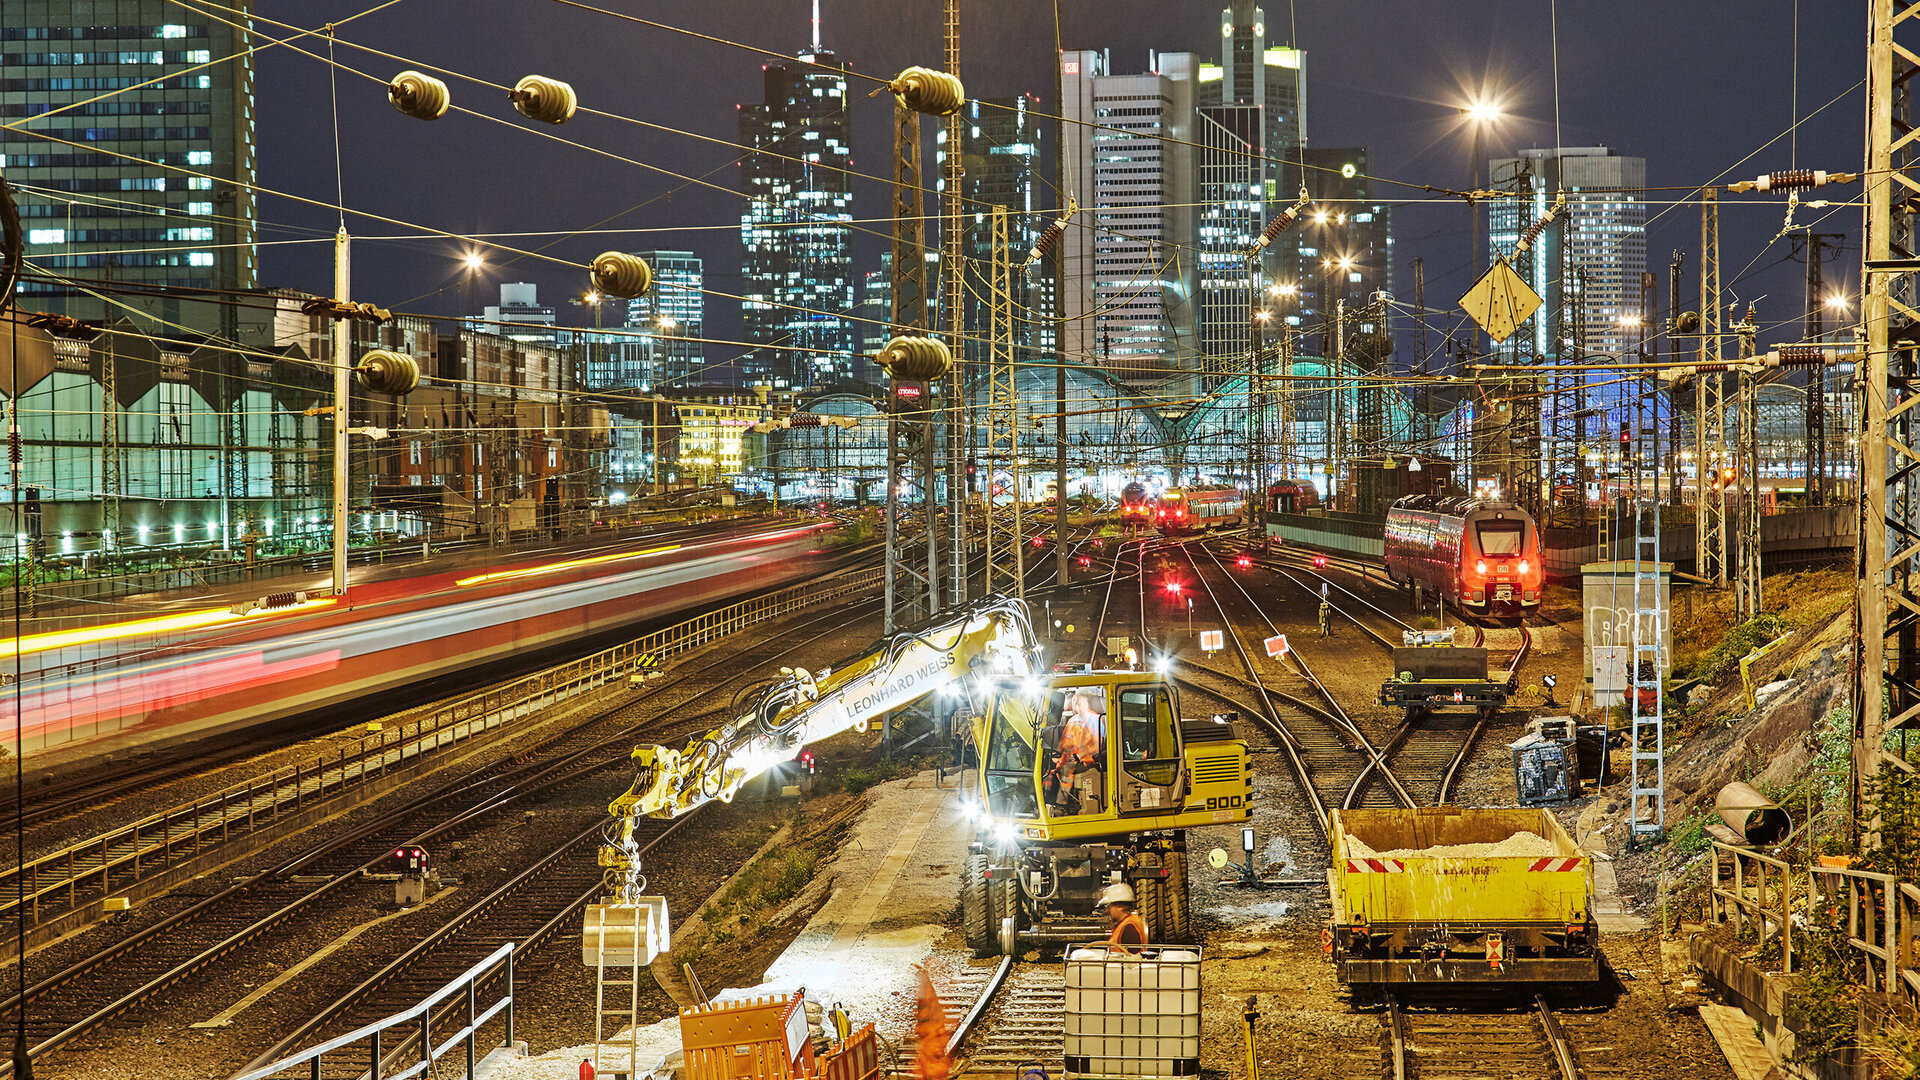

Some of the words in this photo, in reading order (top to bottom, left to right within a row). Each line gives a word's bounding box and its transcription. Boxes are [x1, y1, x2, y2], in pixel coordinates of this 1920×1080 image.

[1065, 63, 1078, 72] DB
[846, 674, 915, 718] LEONHARD
[916, 652, 956, 679] WEISS
[1207, 795, 1241, 809] 900
